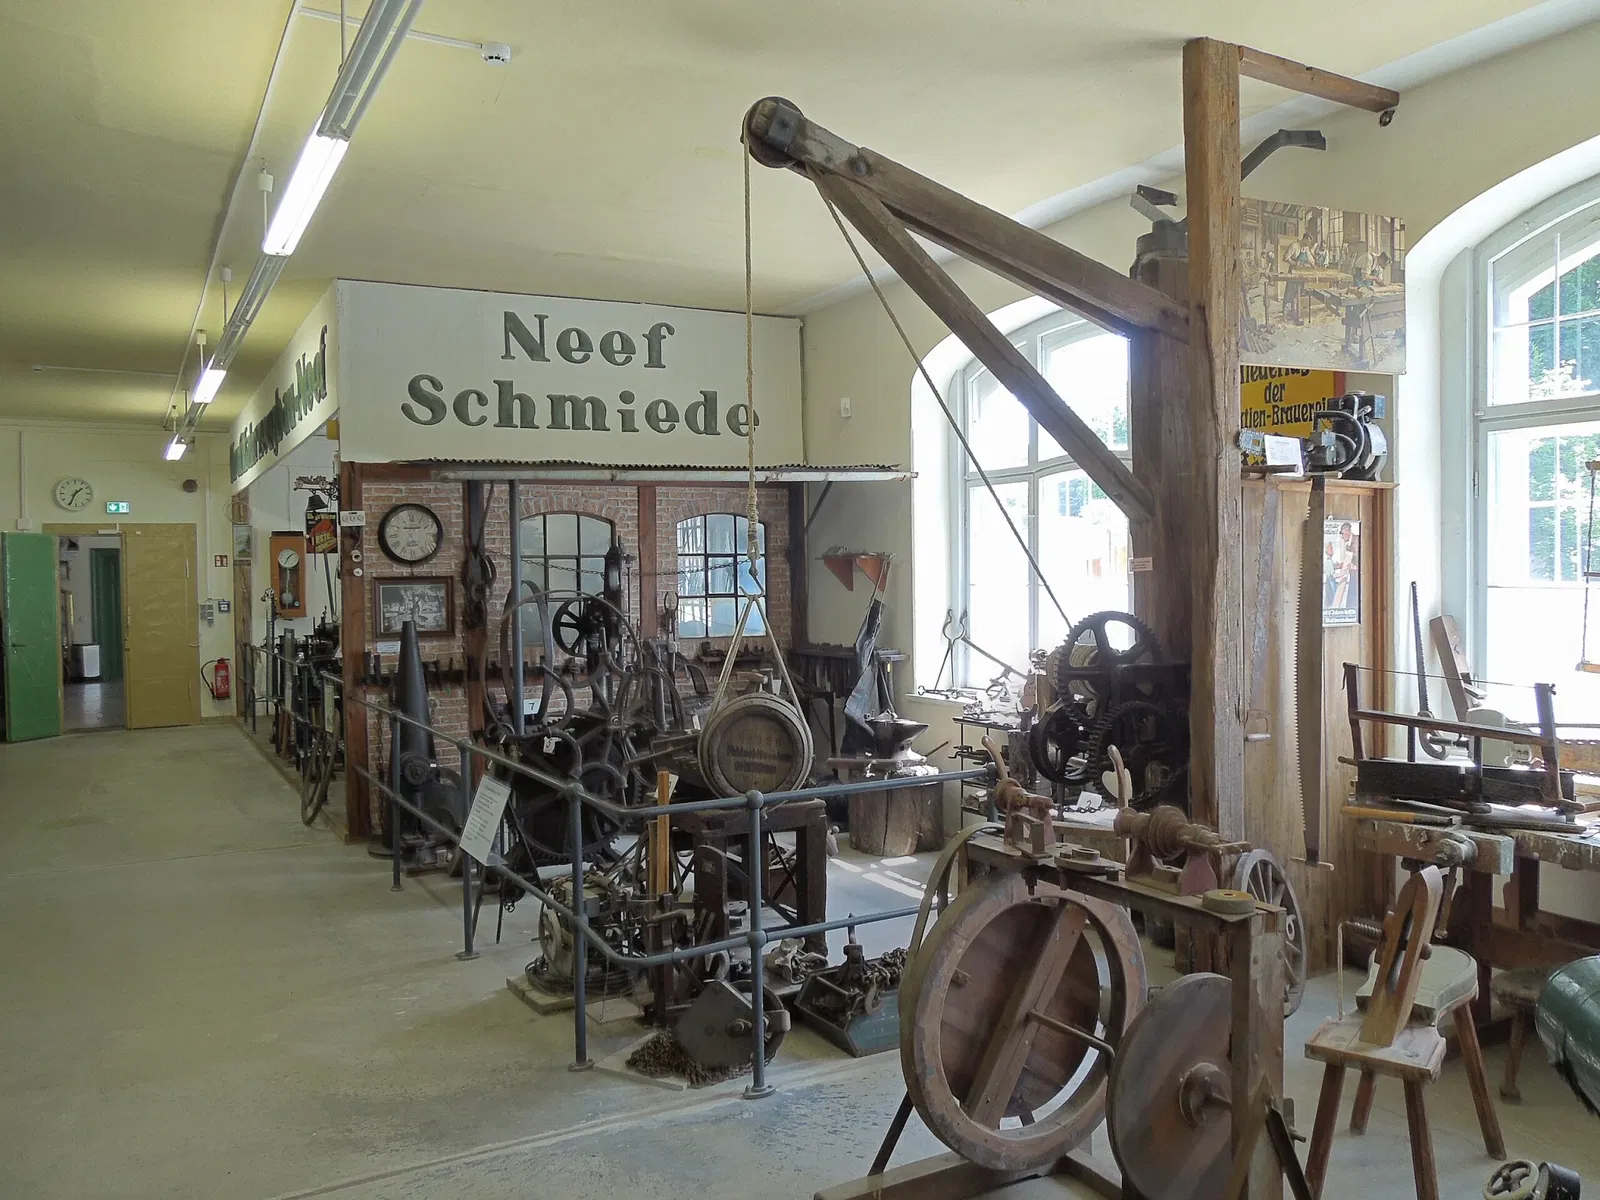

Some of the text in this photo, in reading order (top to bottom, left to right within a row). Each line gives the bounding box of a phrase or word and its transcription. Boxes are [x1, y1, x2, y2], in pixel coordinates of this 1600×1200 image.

[501, 310, 676, 369] Neef
[400, 373, 760, 437] Schmiede
[1264, 382, 1286, 404] der
[528, 702, 535, 711] 7
